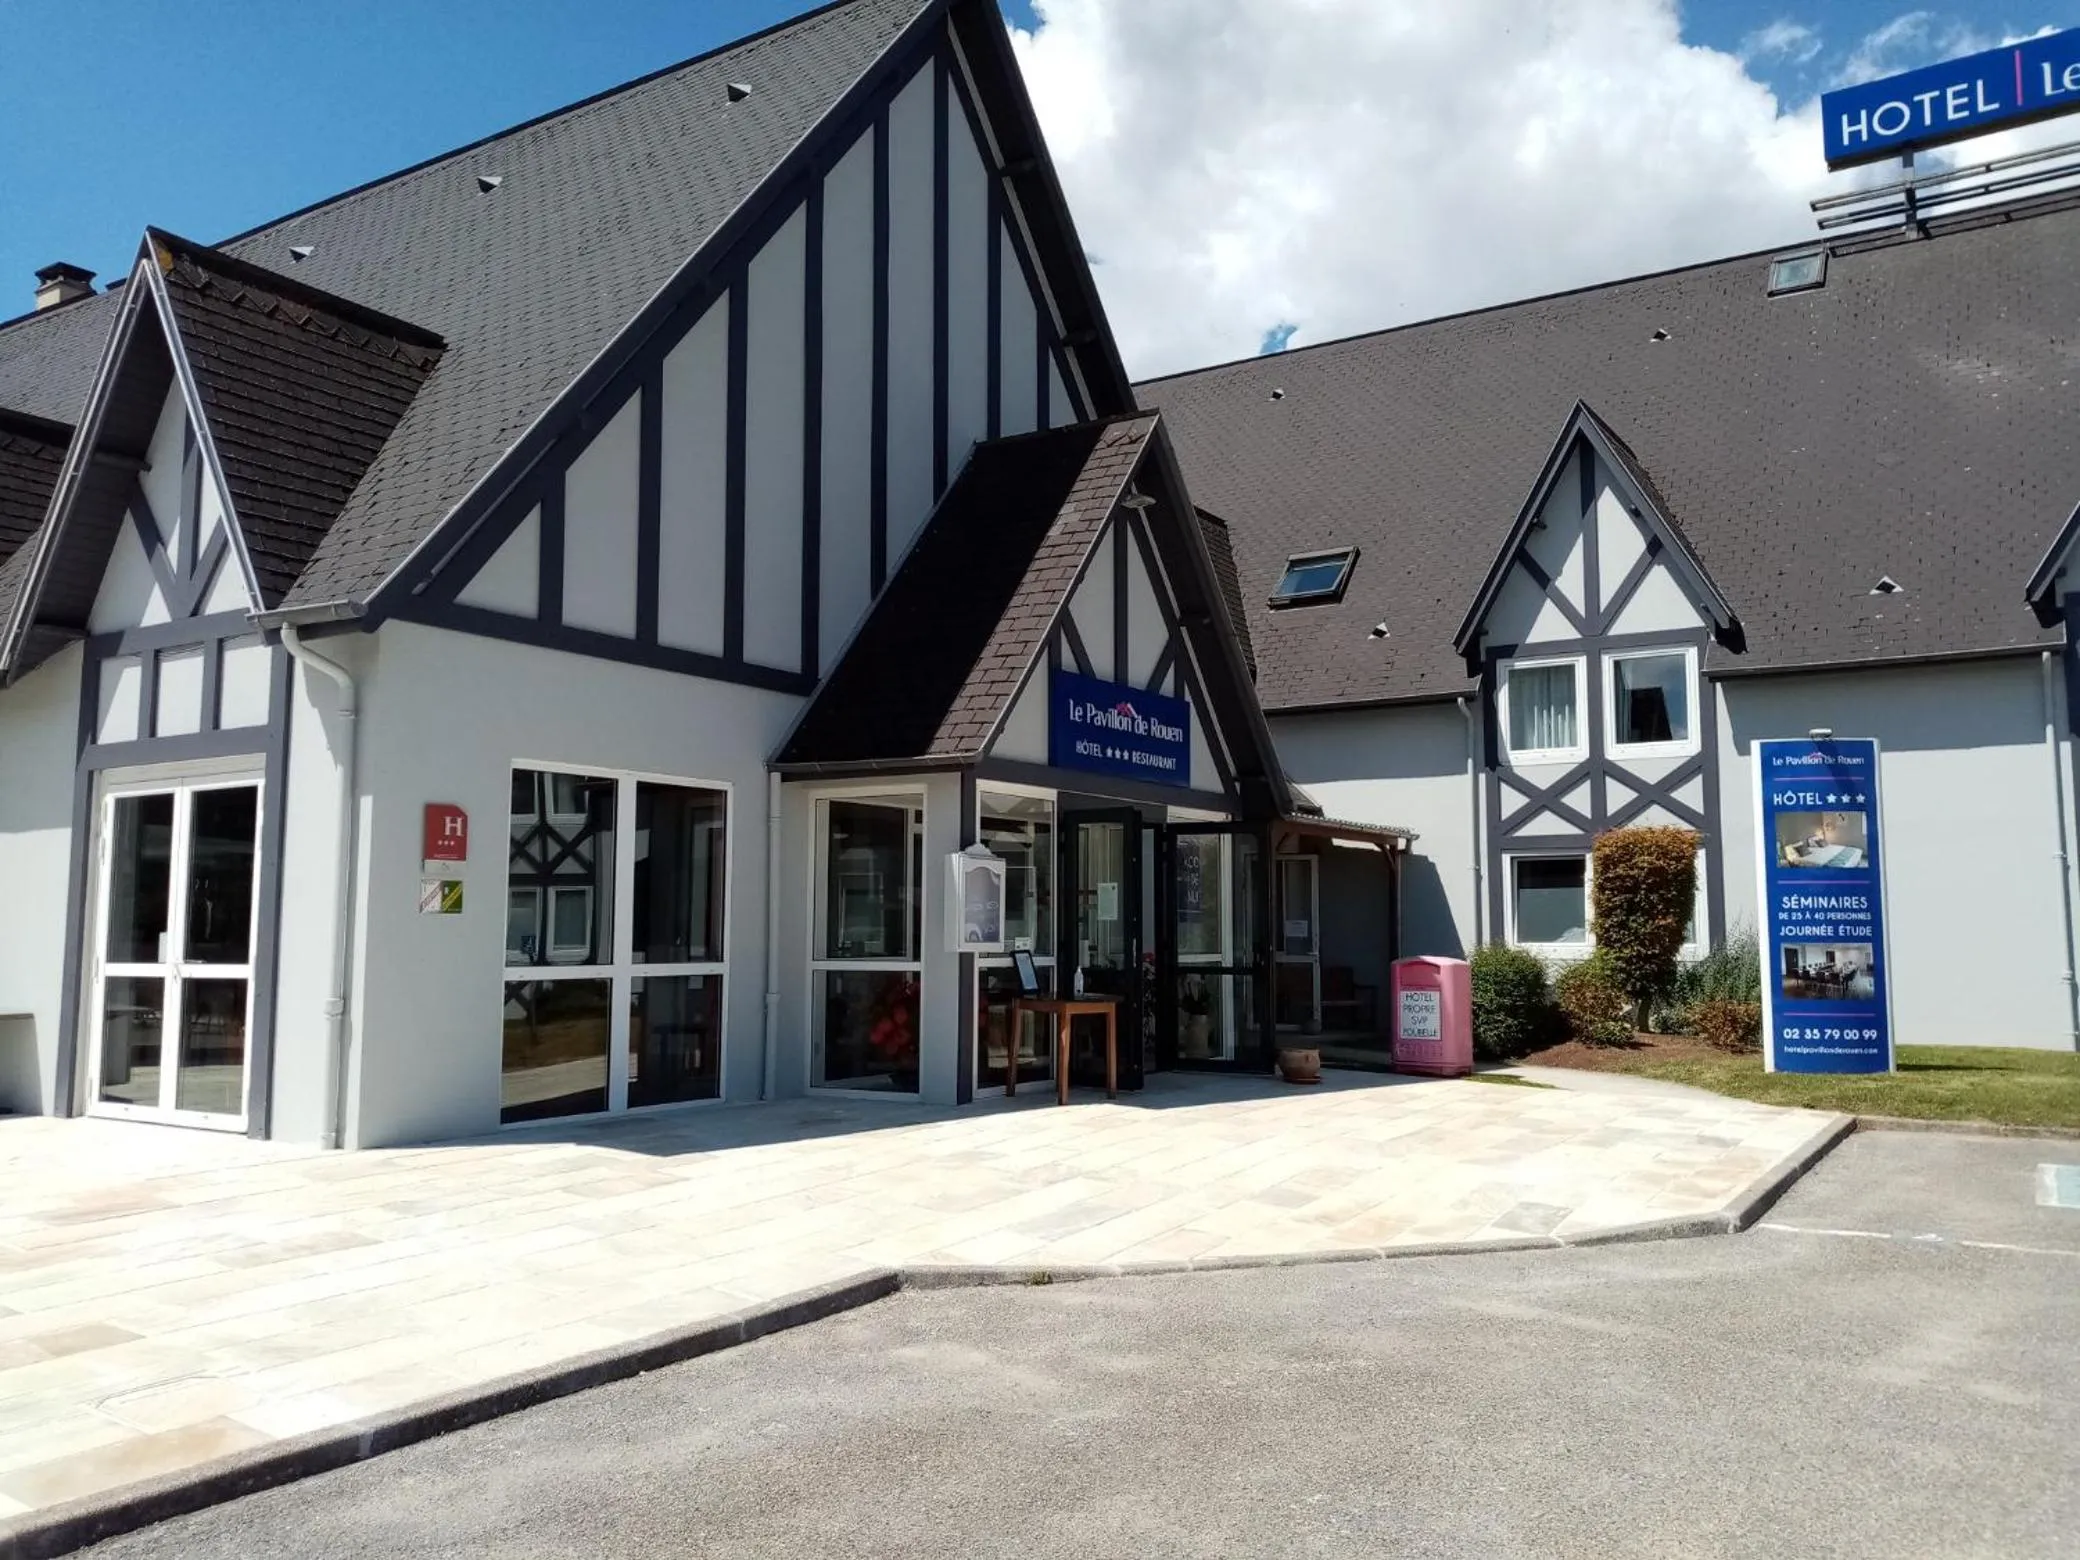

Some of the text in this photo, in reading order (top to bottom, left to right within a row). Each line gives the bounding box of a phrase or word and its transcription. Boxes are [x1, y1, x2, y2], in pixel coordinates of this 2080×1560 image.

[1841, 79, 2000, 146] HOTEL
[1069, 698, 1183, 743] Le Pavillon de Rouen
[1075, 738, 1177, 770] HÔTEL RESTAURANT
[1772, 756, 1784, 766] Le
[1785, 755, 1823, 765] Pavillon
[1837, 755, 1865, 765] Rouen
[1773, 789, 1823, 806] HÔTEL
[444, 816, 463, 836] H
[1782, 893, 1868, 909] SÉMINAIRES
[1778, 911, 1789, 920] DE
[1804, 910, 1812, 920] À
[1814, 911, 1825, 920] 40
[1826, 911, 1872, 921] PERSONNES
[1779, 923, 1873, 937] JOURNÉE ÉTUDE
[1405, 992, 1433, 1002] HOTEL
[1403, 1004, 1436, 1014] PROPRE
[1410, 1015, 1429, 1026] SVP
[1783, 1028, 1878, 1040] 02 35 79 00 99
